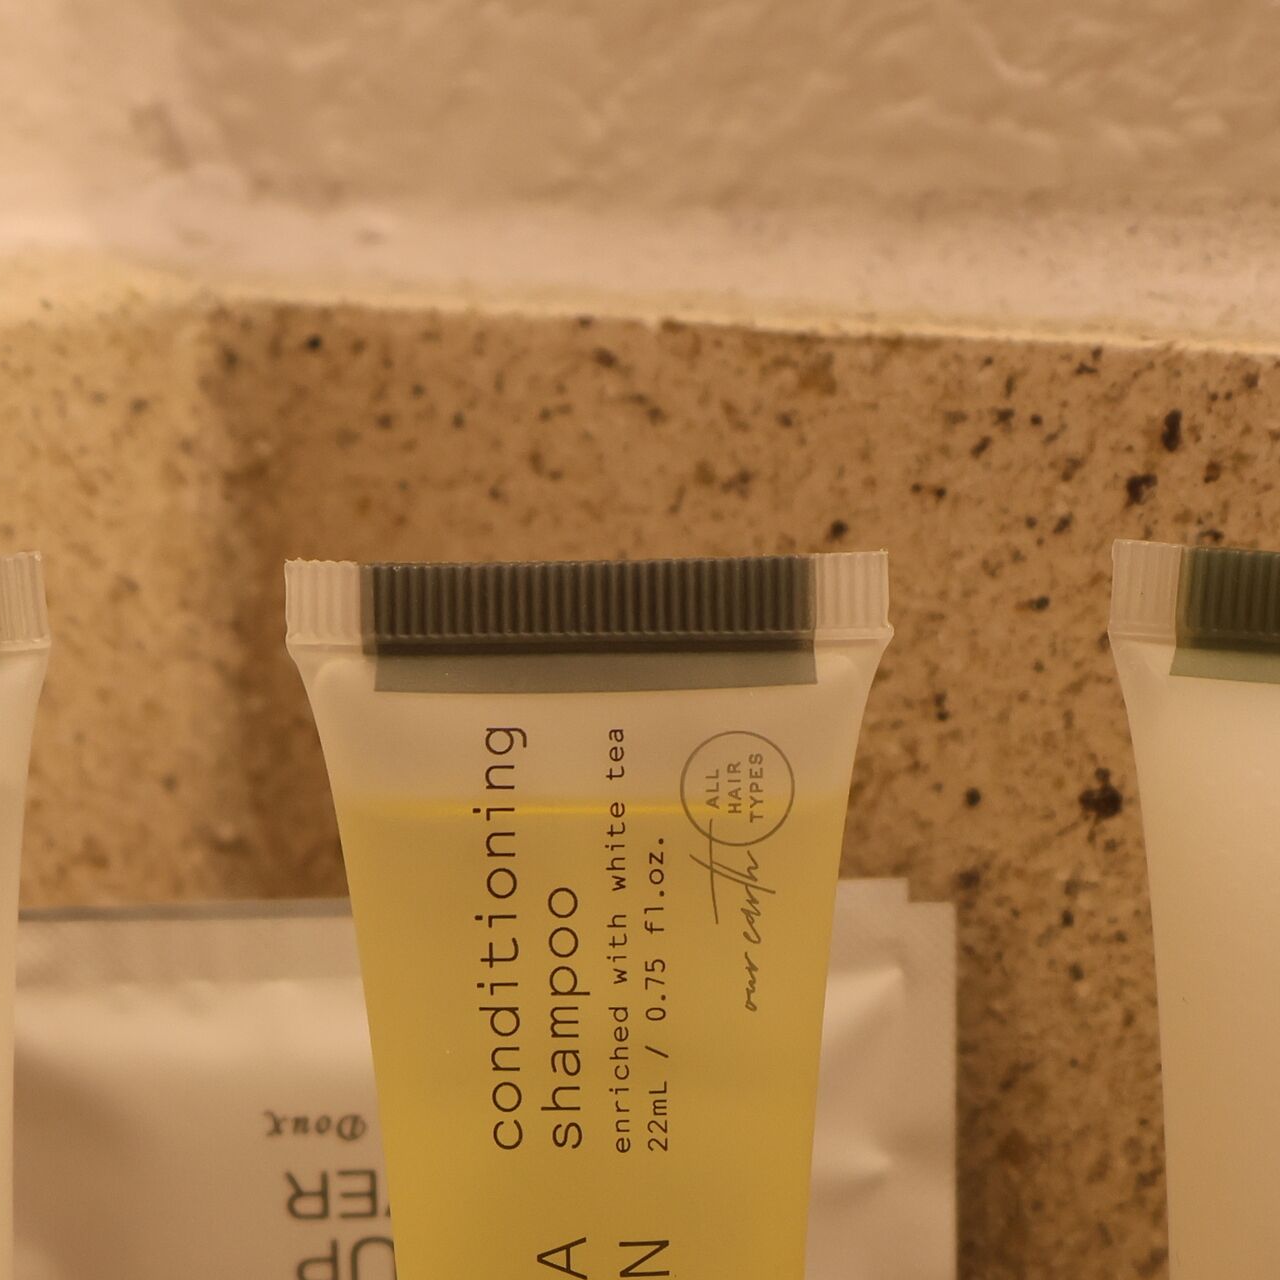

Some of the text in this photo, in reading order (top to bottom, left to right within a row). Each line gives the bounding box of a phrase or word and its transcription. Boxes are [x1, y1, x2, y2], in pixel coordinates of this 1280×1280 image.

[705, 768, 720, 810] ALL
[727, 762, 742, 814] HAIR
[748, 753, 765, 823] TYPES
[473, 725, 525, 1151] conditioning
[541, 886, 589, 1150] shampoo
[605, 728, 630, 1153] enriched with white tea
[645, 837, 669, 1152] 22mL / 0.75 fl.oz.
[284, 1169, 390, 1220] ER
